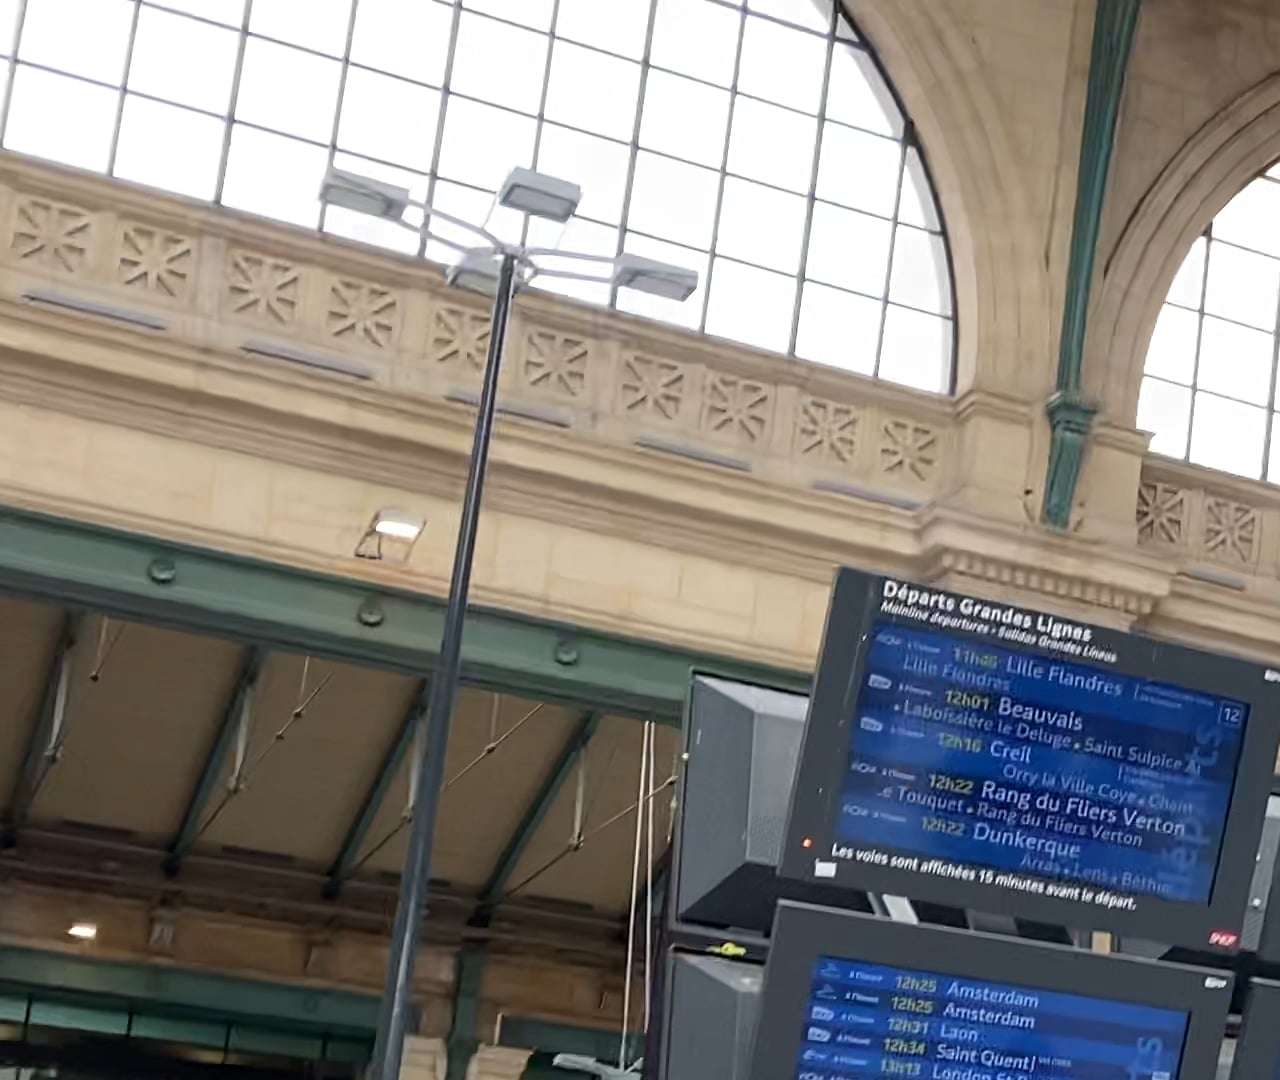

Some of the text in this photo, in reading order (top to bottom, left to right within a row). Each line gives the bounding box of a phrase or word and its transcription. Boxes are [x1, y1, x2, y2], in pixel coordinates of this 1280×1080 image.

[883, 580, 1093, 642] Départs Grandes Lignes
[1007, 655, 1044, 680] Lille
[1047, 666, 1123, 697] Flandres
[998, 696, 1084, 731] Beauvais
[1222, 707, 1242, 723] 12
[990, 740, 1032, 763] Creil
[1084, 737, 1124, 760] Saint
[981, 780, 1032, 811] Rang
[1036, 793, 1062, 812] du
[1066, 798, 1118, 825] Fliers
[1123, 809, 1187, 837] Verton
[972, 823, 1082, 859] Dunkerque
[1091, 825, 1144, 848] Verton
[831, 842, 853, 860] Les
[855, 848, 889, 867] voies
[889, 855, 919, 873] sont
[1045, 882, 1081, 902] avant
[946, 981, 1040, 1008] Amsterdam
[943, 1002, 1035, 1030] Amsterdam
[940, 1023, 978, 1043] Laon
[936, 1043, 977, 1065] Saint
